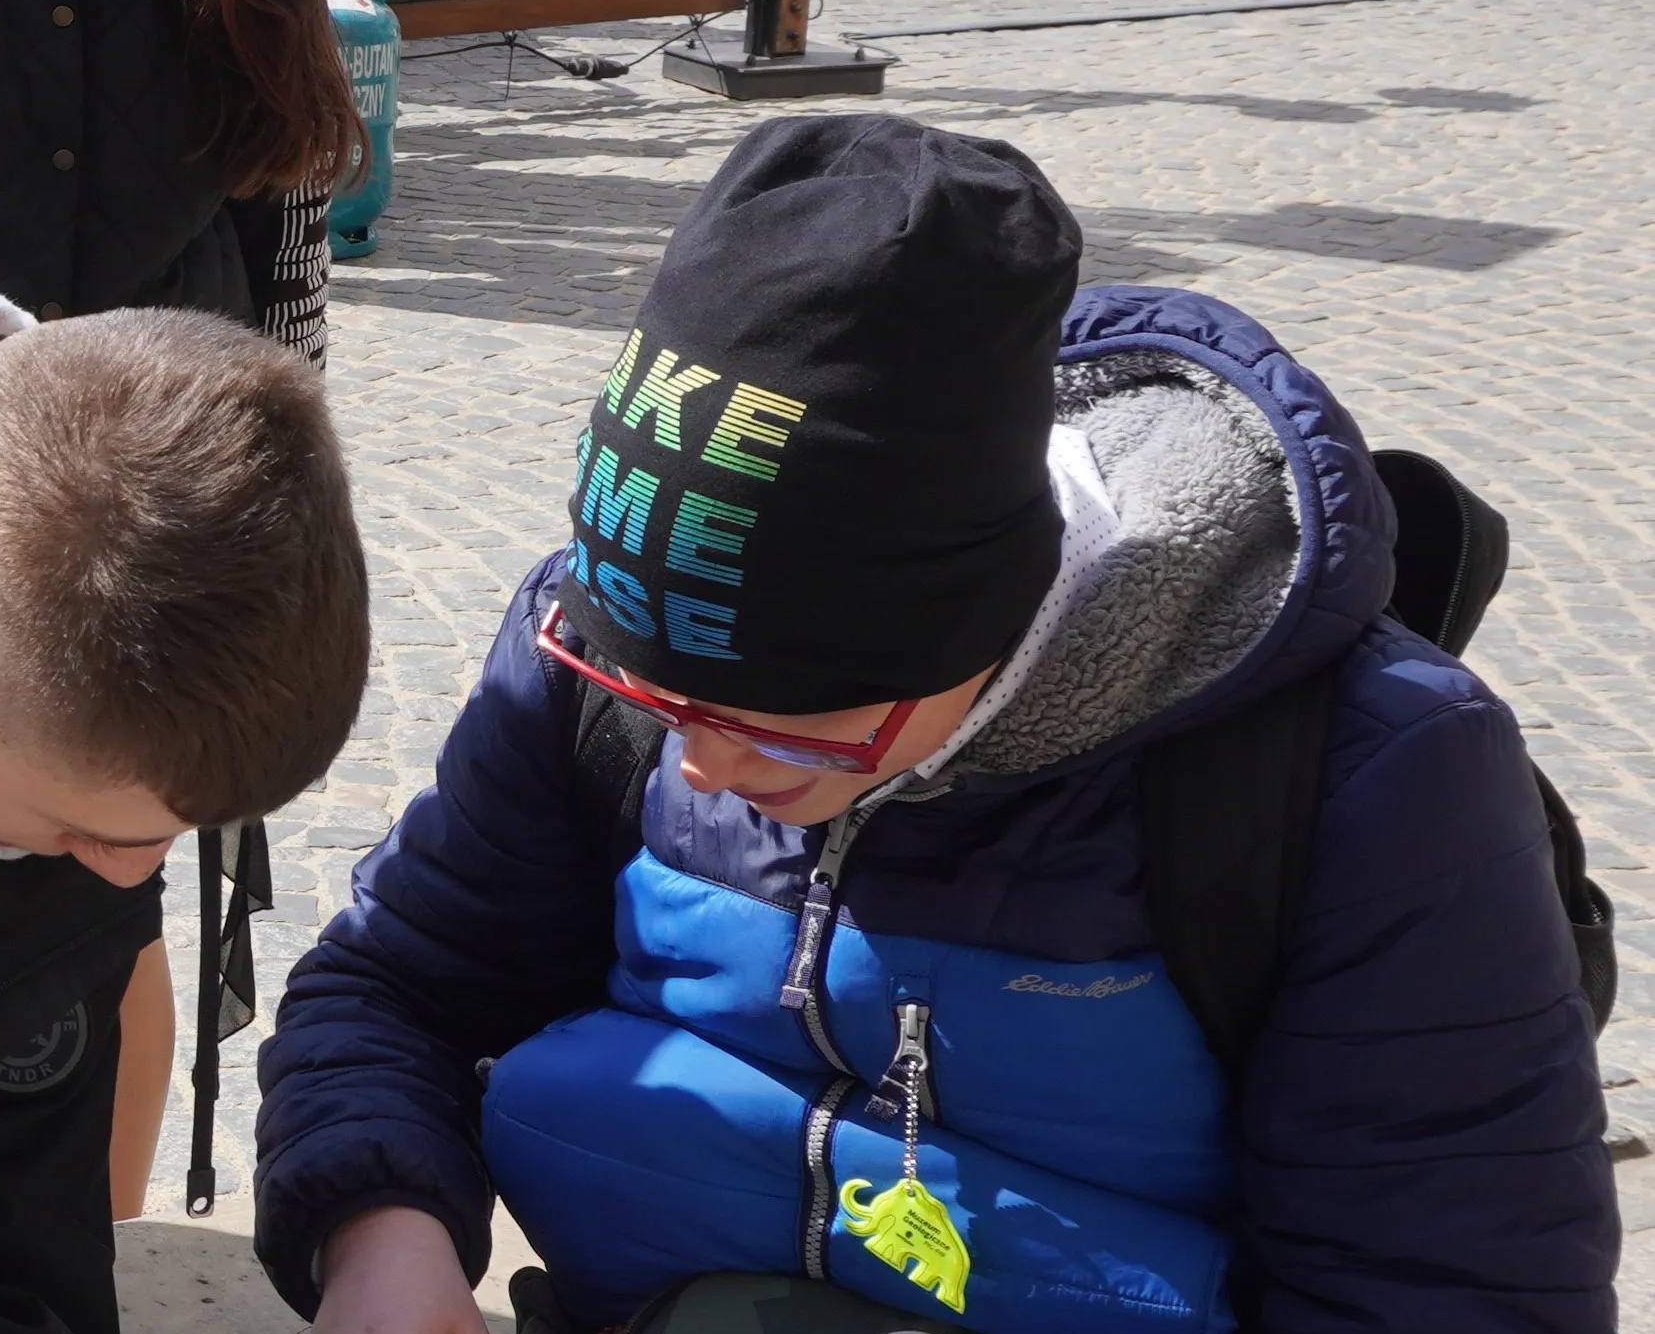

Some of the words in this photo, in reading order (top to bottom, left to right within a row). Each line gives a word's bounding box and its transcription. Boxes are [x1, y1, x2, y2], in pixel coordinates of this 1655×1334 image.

[600, 328, 807, 482] AKE
[1000, 974, 1083, 998] Eddie
[1082, 971, 1155, 999] Bauer
[907, 1209, 941, 1235] Muzeum
